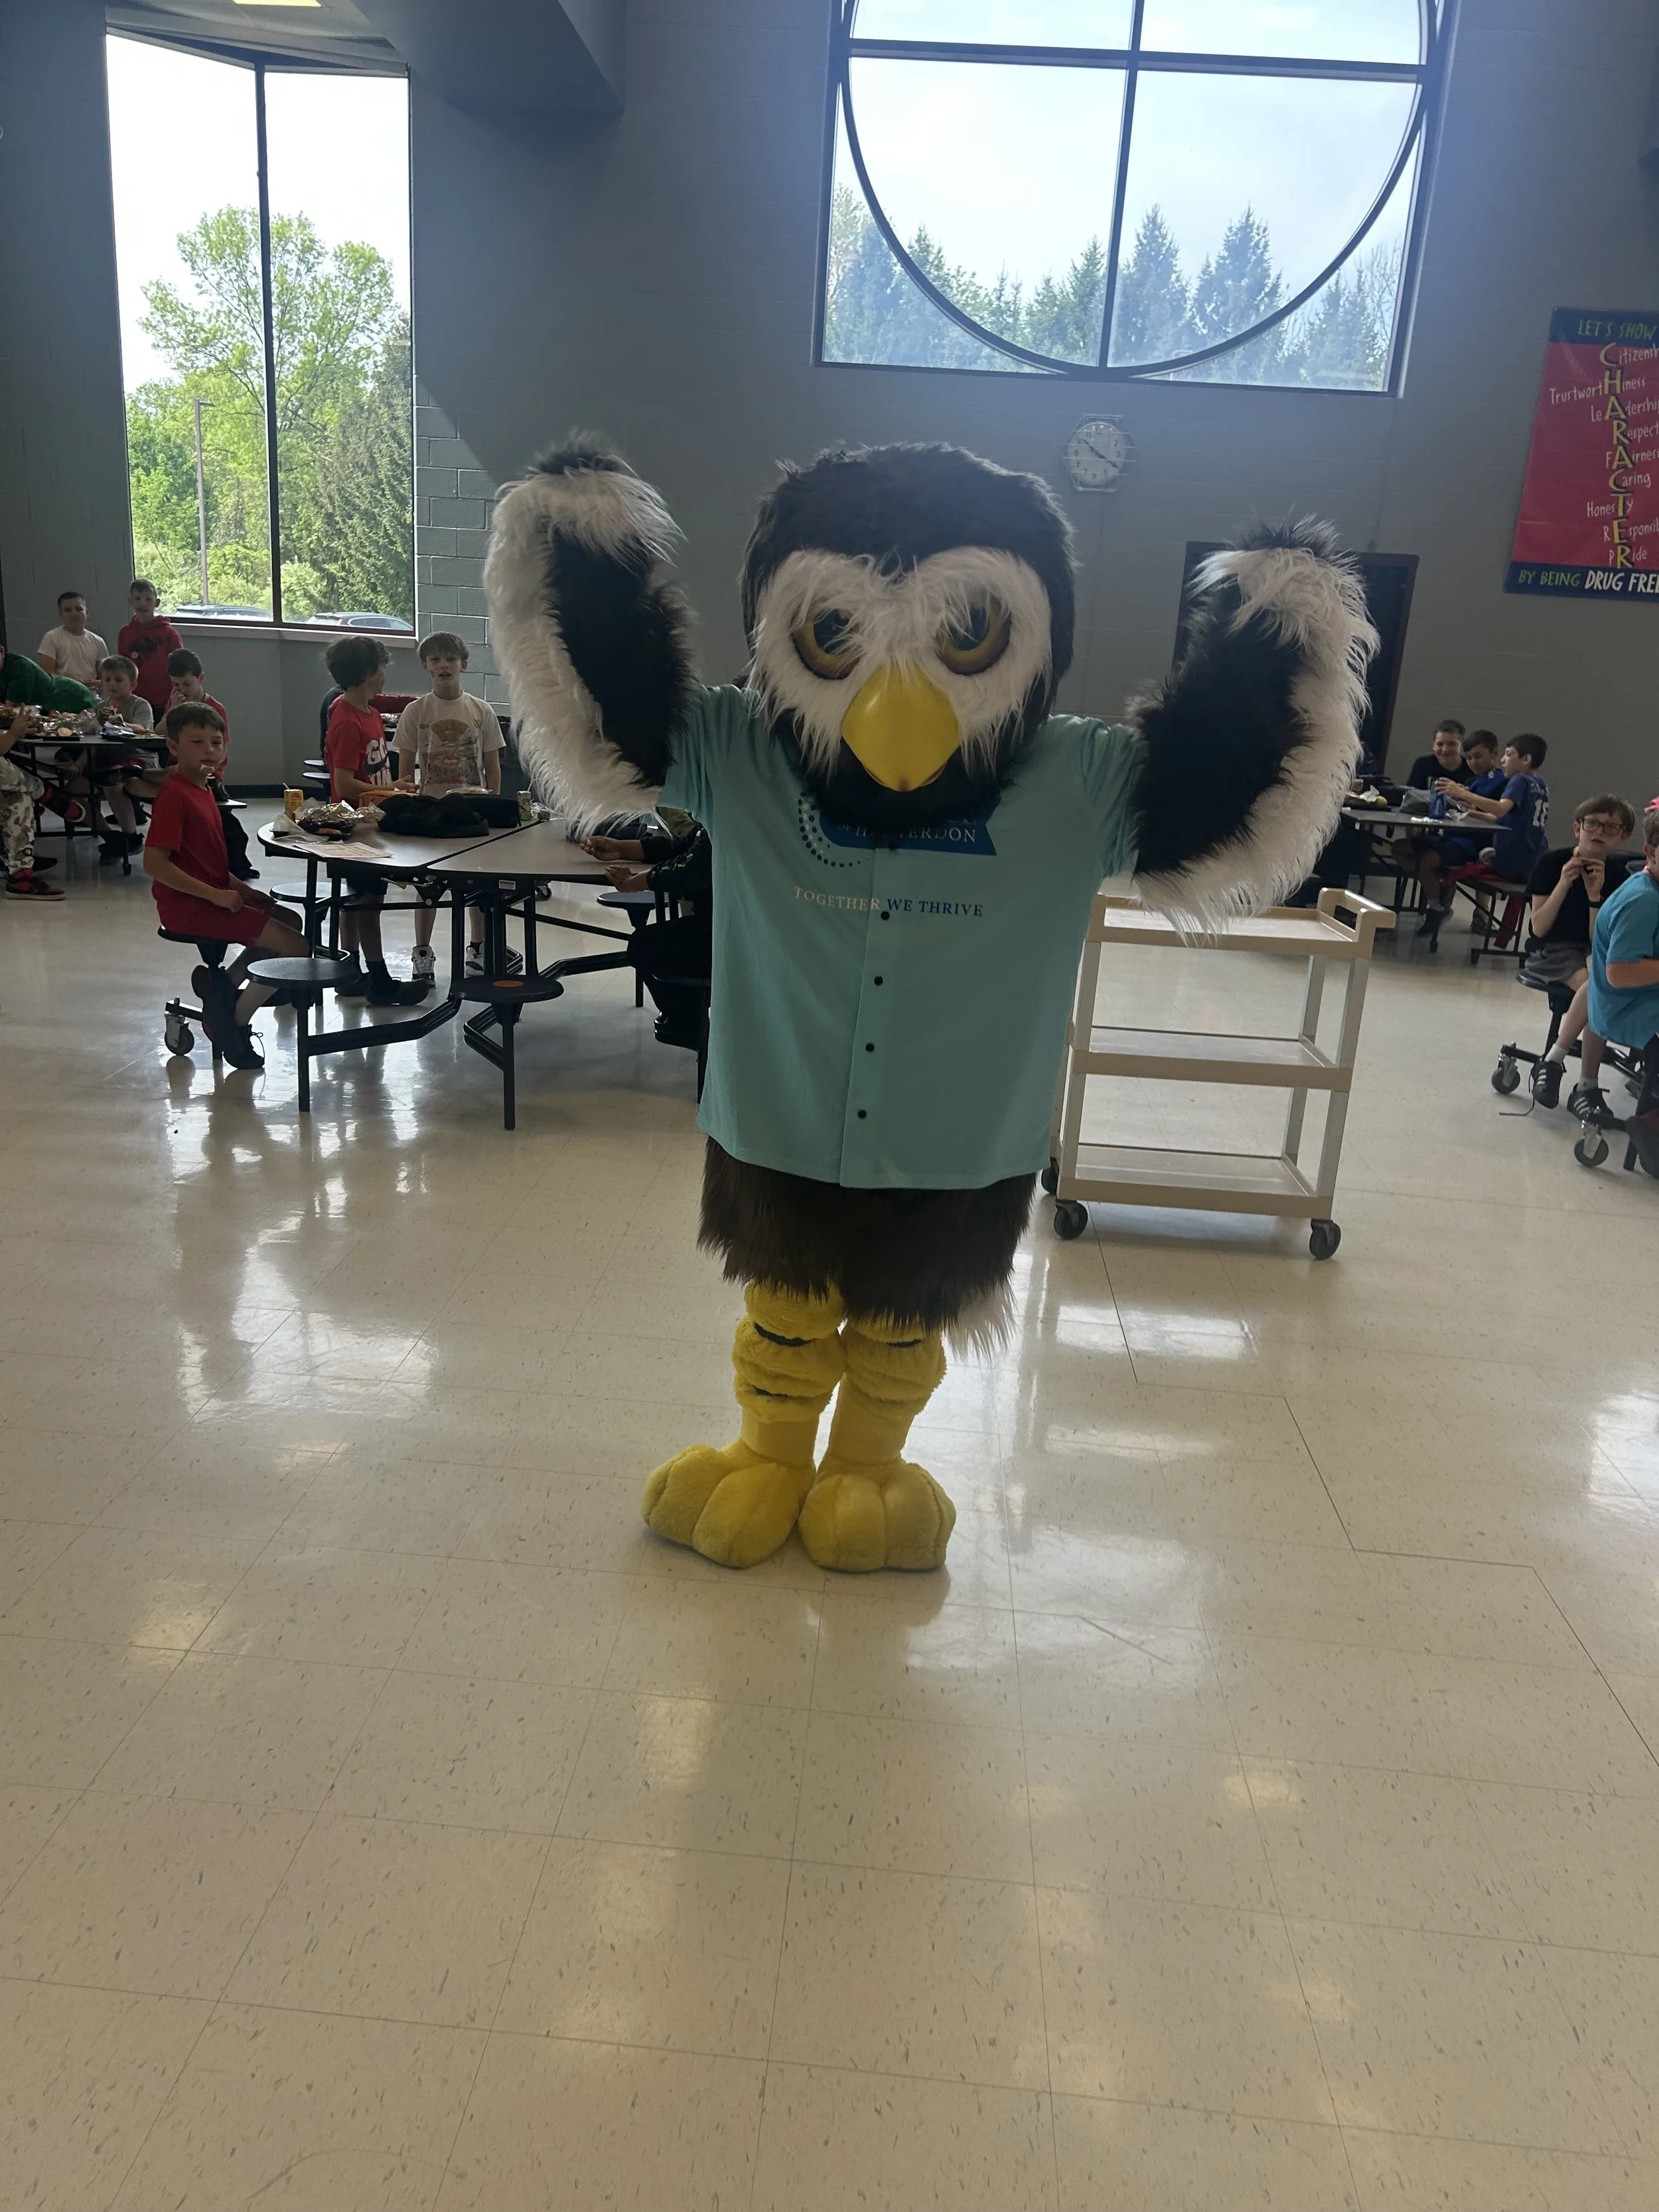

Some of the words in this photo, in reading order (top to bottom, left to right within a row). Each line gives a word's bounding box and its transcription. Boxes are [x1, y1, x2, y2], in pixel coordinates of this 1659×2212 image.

[1578, 319, 1614, 336] LET'S
[1619, 323, 1658, 340] SHOW
[1518, 569, 1536, 584] BY
[1540, 571, 1581, 587] BEING
[1585, 569, 1625, 591] DRUG
[794, 885, 881, 911] TOGETHER
[887, 898, 912, 911] WE
[919, 900, 983, 917] THRIVE
